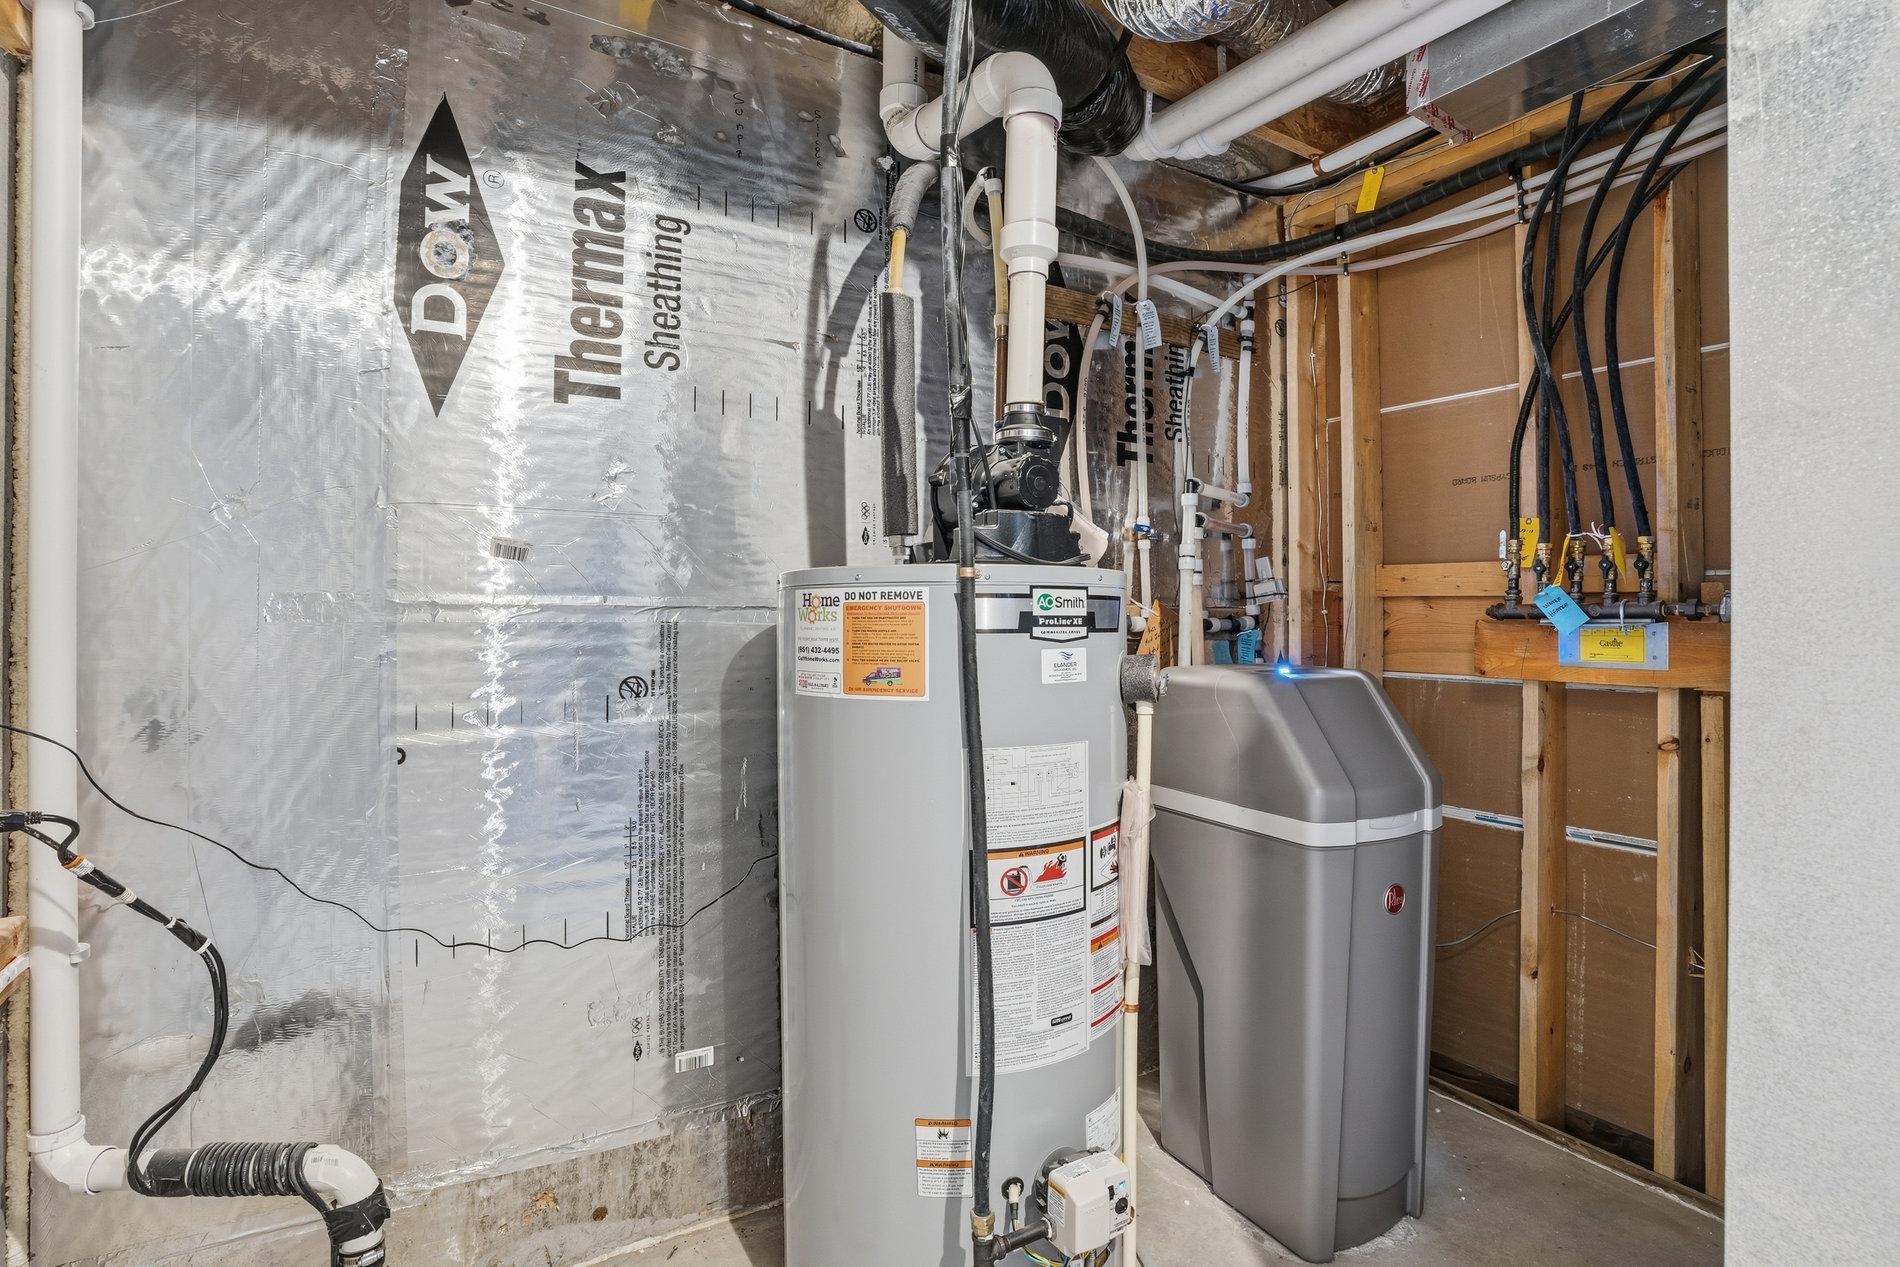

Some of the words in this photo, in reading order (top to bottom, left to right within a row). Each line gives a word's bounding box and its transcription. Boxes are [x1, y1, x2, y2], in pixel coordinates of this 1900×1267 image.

[554, 159, 626, 404] Thermax
[643, 214, 691, 371] Sheathing
[802, 593, 840, 608] Home
[844, 592, 856, 600] DO
[858, 592, 877, 600] NOT
[880, 591, 923, 600] REMOVE
[1055, 596, 1084, 608] Smith
[798, 608, 837, 624] Works
